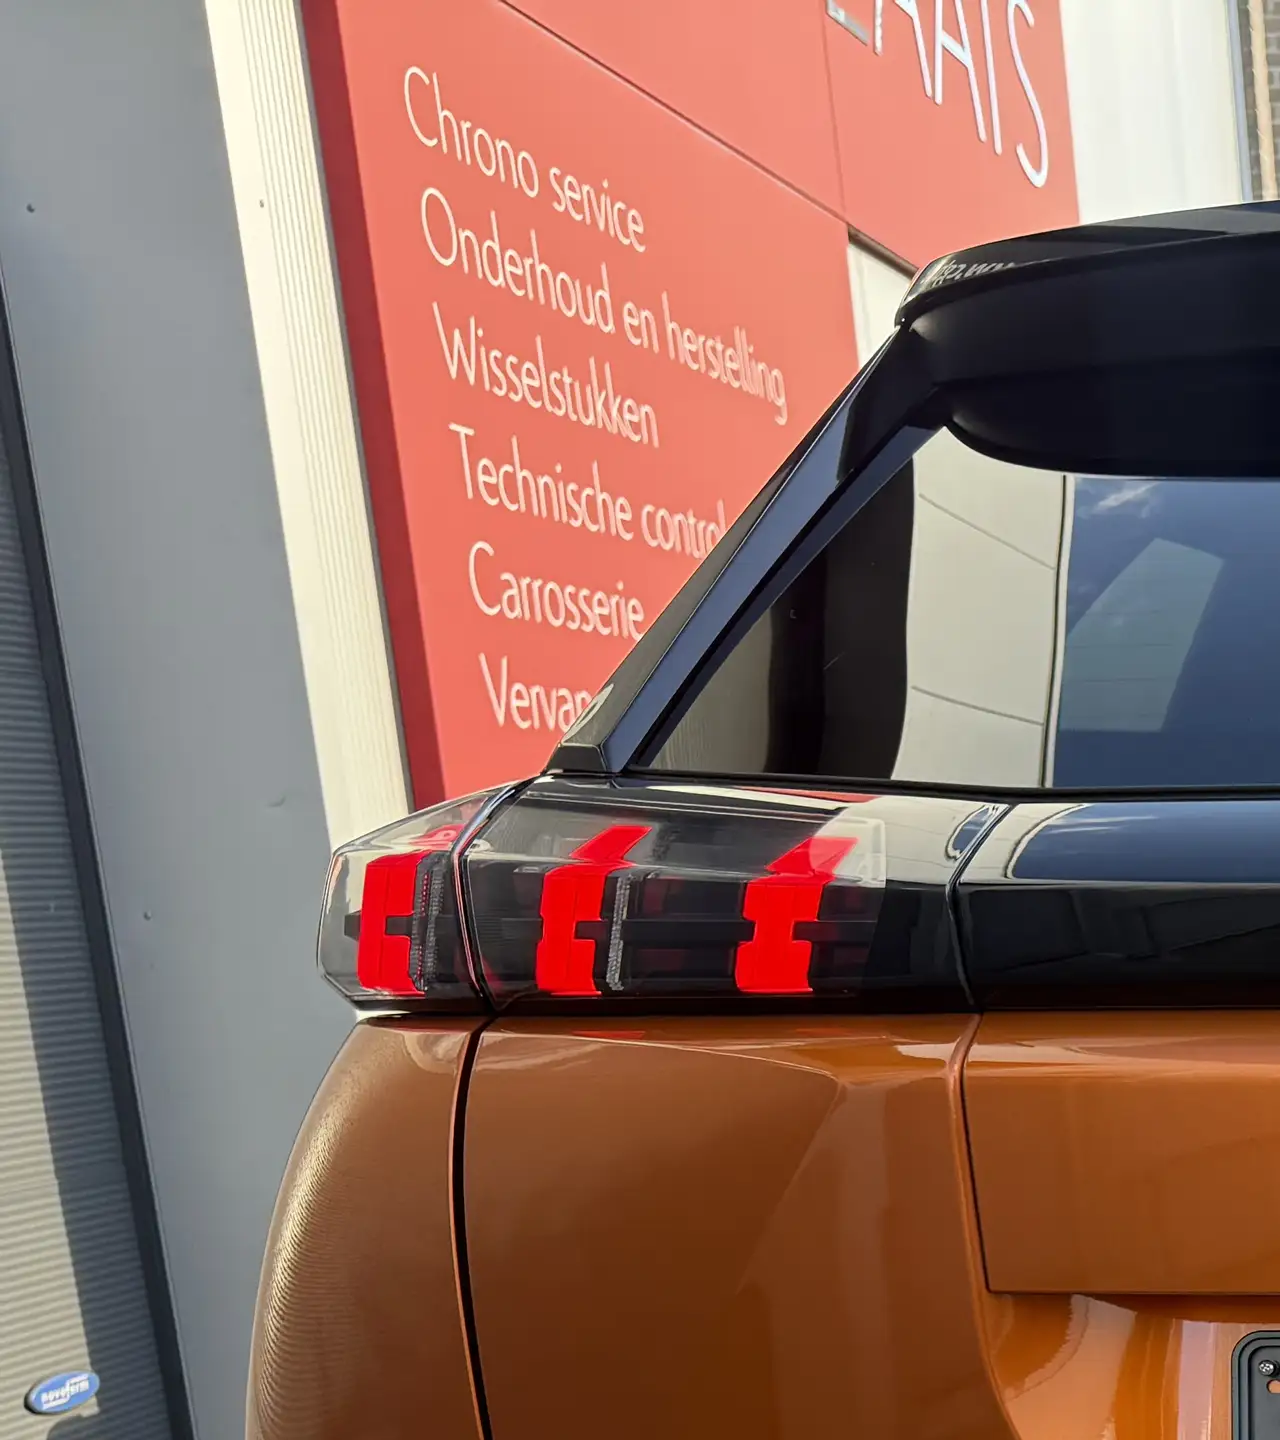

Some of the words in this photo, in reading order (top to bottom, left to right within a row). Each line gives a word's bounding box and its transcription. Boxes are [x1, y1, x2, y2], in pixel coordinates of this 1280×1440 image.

[404, 66, 540, 198] Chrono
[549, 166, 647, 253] service
[421, 187, 616, 334] Onderhoud
[623, 300, 660, 354] en
[662, 291, 788, 427] herstelling
[433, 302, 660, 448] Wisselstukken
[449, 422, 634, 541] Technische
[469, 540, 645, 641] Carrosserie
